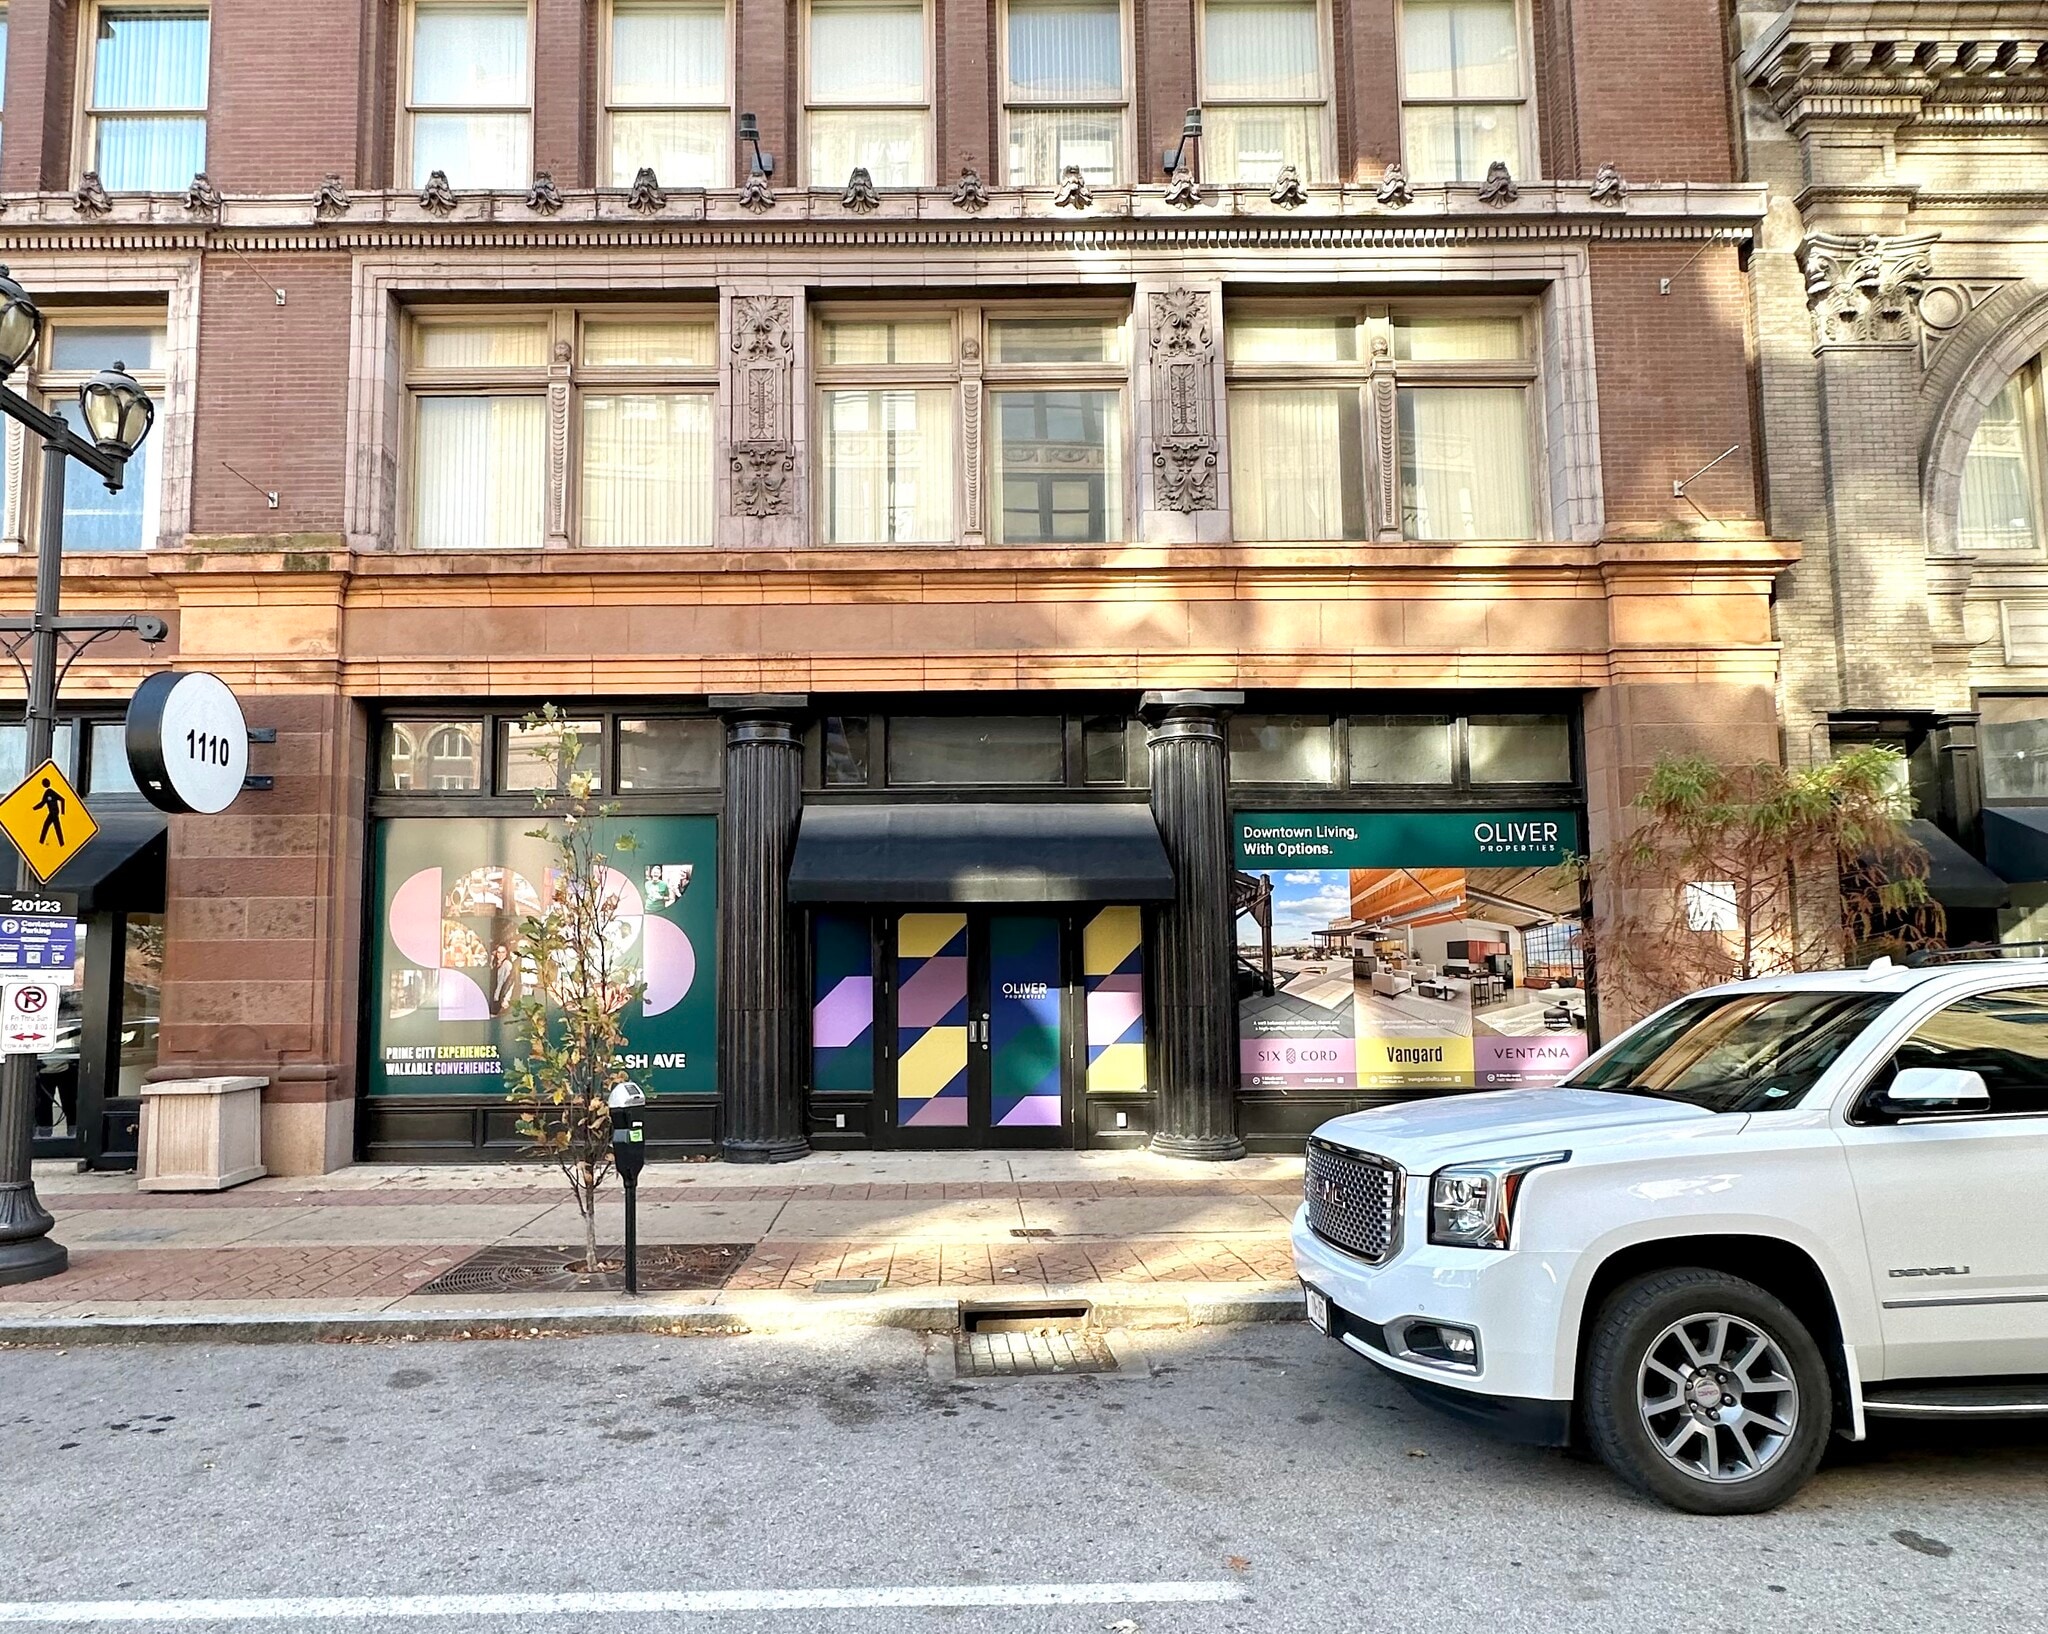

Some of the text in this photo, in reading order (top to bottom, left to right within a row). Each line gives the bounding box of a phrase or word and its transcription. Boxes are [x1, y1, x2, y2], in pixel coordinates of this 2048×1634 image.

[187, 729, 229, 767] 1110
[1243, 826, 1358, 840] Downtown Living,
[1474, 823, 1557, 842] OLIVER
[1243, 843, 1333, 858] With Options.
[1480, 844, 1555, 852] PROPERTIES
[11, 899, 61, 913] 20123
[21, 927, 51, 935] Parking
[1002, 983, 1047, 994] OLIVER
[386, 1045, 500, 1059] PRIME CITY EXPERIENCES,
[1258, 1051, 1338, 1061] SIX CORD
[1387, 1046, 1443, 1064] Vangard
[1494, 1048, 1570, 1058] VENTANA
[652, 1053, 686, 1068] AVE
[385, 1061, 504, 1075] WALKABLE CONVENIENCES.
[1888, 1265, 1970, 1278] DENALI
